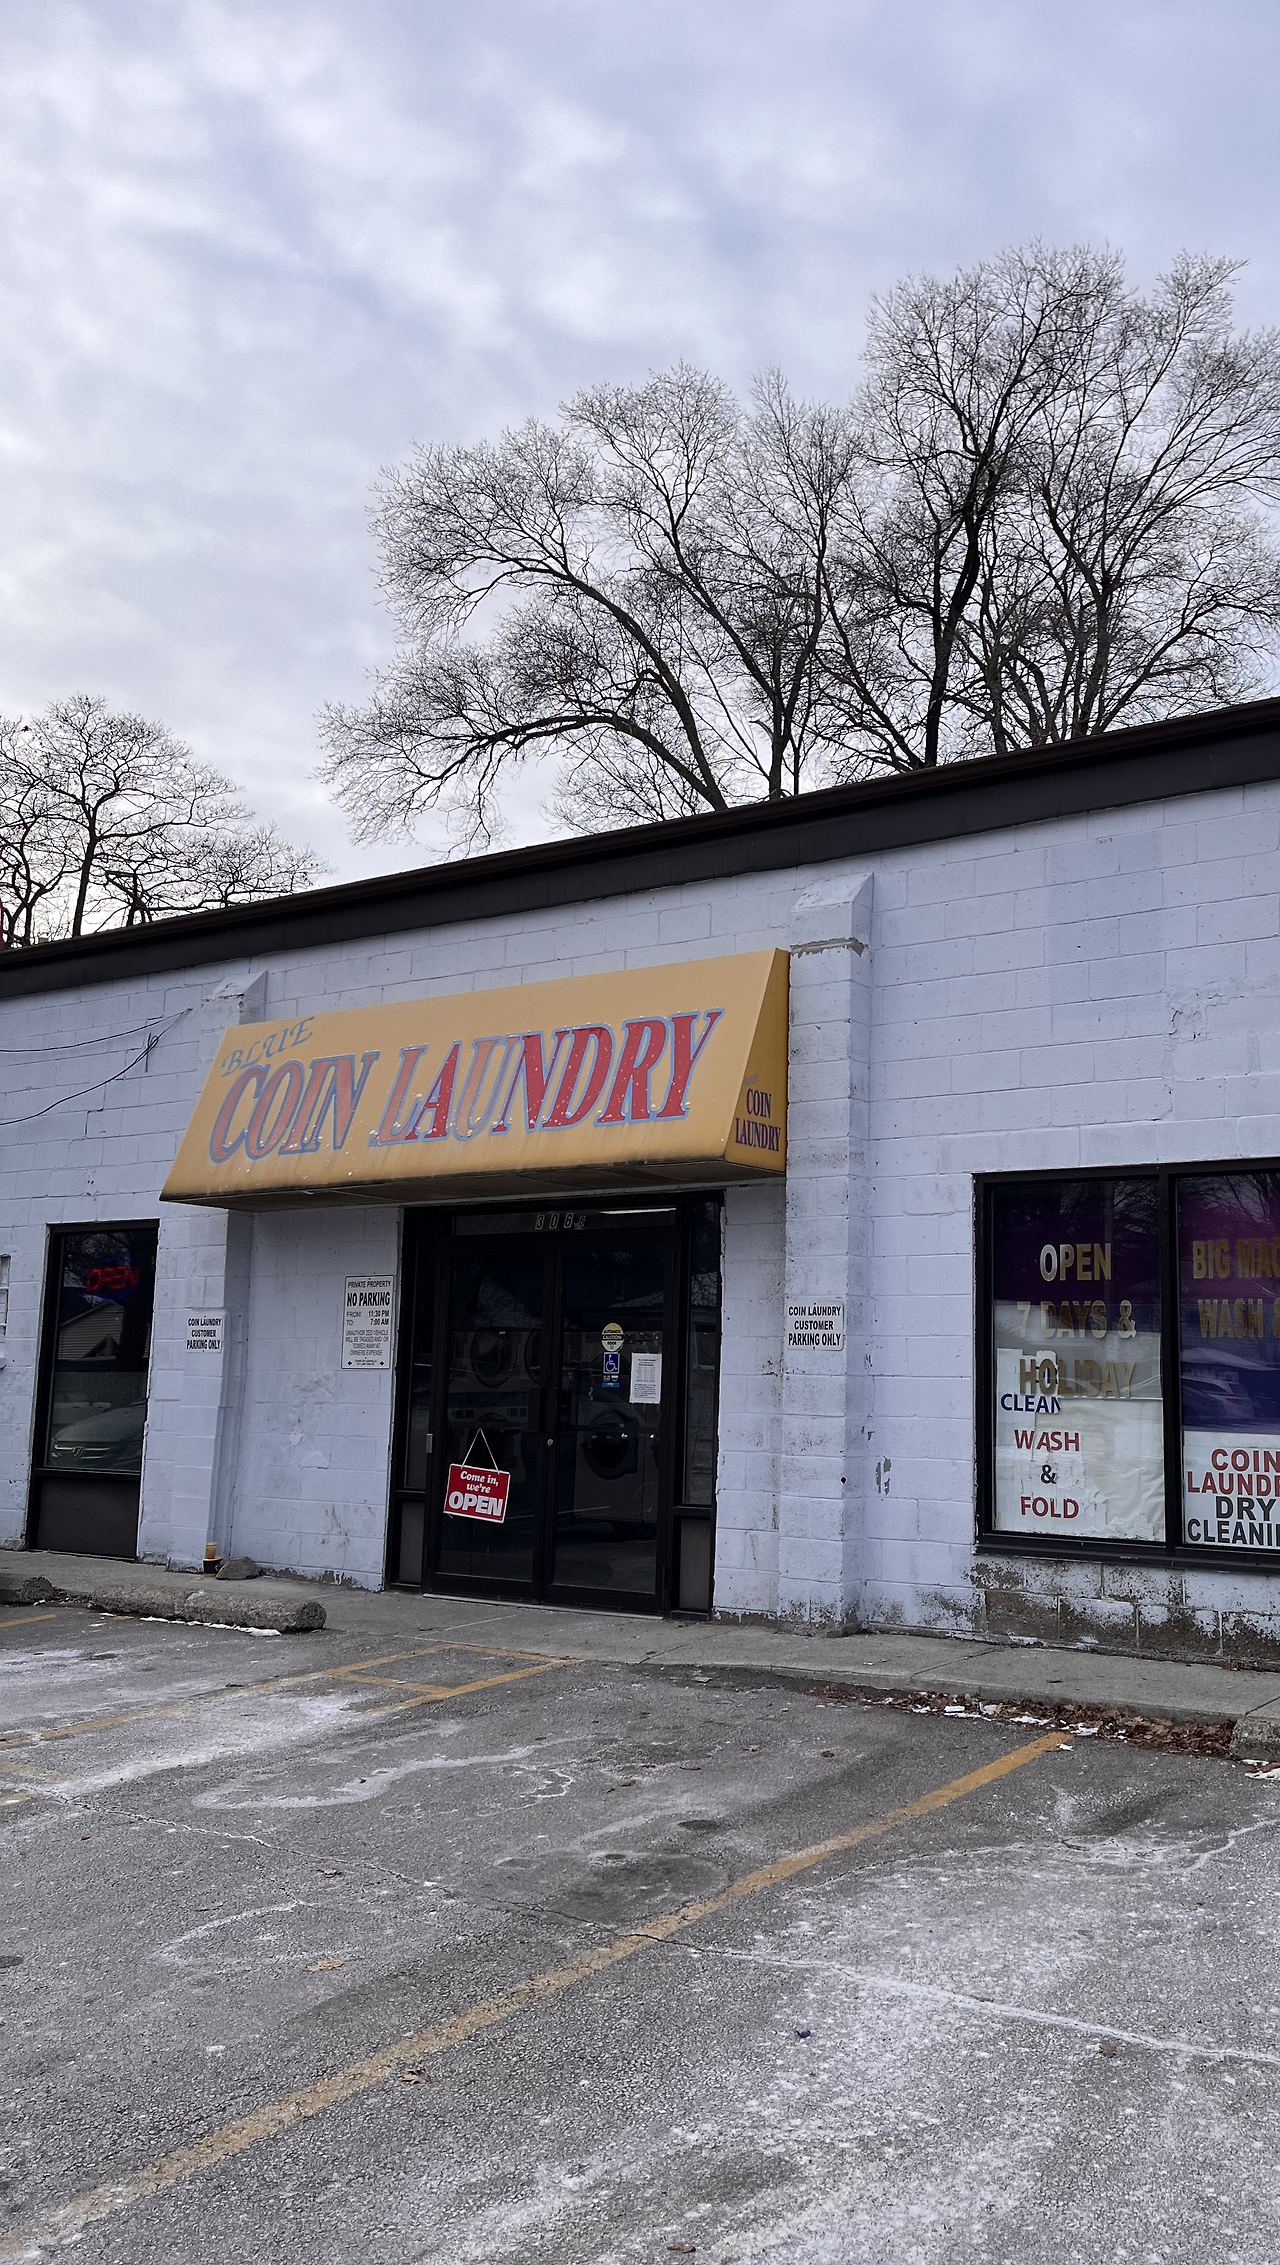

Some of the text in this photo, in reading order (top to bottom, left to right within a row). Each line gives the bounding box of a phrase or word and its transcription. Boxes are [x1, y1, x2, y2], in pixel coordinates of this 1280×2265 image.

[221, 1016, 315, 1077] BLUE
[209, 1008, 725, 1164] COIN LAUNDRY
[746, 1088, 772, 1118] COIN
[735, 1117, 781, 1152] LAUNDRY
[1040, 1243, 1112, 1282] OPEN
[1193, 1239, 1230, 1279] BIG
[87, 1266, 140, 1291] OPEN
[348, 1280, 391, 1288] PRIVATE PROPERTY
[347, 1291, 390, 1307] NO PARKING
[188, 1318, 221, 1326] COIN LAUNDRY
[381, 1309, 389, 1317] PM
[381, 1318, 389, 1326] AM
[788, 1306, 841, 1316] COIN LAUNDRY
[1017, 1300, 1137, 1339] 7 DAYS &
[1198, 1298, 1264, 1338] WASH
[191, 1329, 217, 1338] CUSTOMER
[794, 1320, 834, 1331] CUSTOMER
[186, 1339, 221, 1350] PARKING ONLY
[788, 1332, 841, 1346] PARKING ONLY
[1019, 1358, 1136, 1398] HOLIDAY
[1000, 1394, 1061, 1414] CLEAN
[1014, 1429, 1080, 1452] WASH
[1211, 1448, 1280, 1473] COIN
[460, 1470, 499, 1487] Come in,
[1041, 1464, 1057, 1484] &
[466, 1483, 491, 1494] we're
[448, 1491, 504, 1517] OPEN
[1020, 1496, 1080, 1519] FOLD
[1216, 1496, 1277, 1521] DRY
[1187, 1518, 1280, 1546] CLEANI
